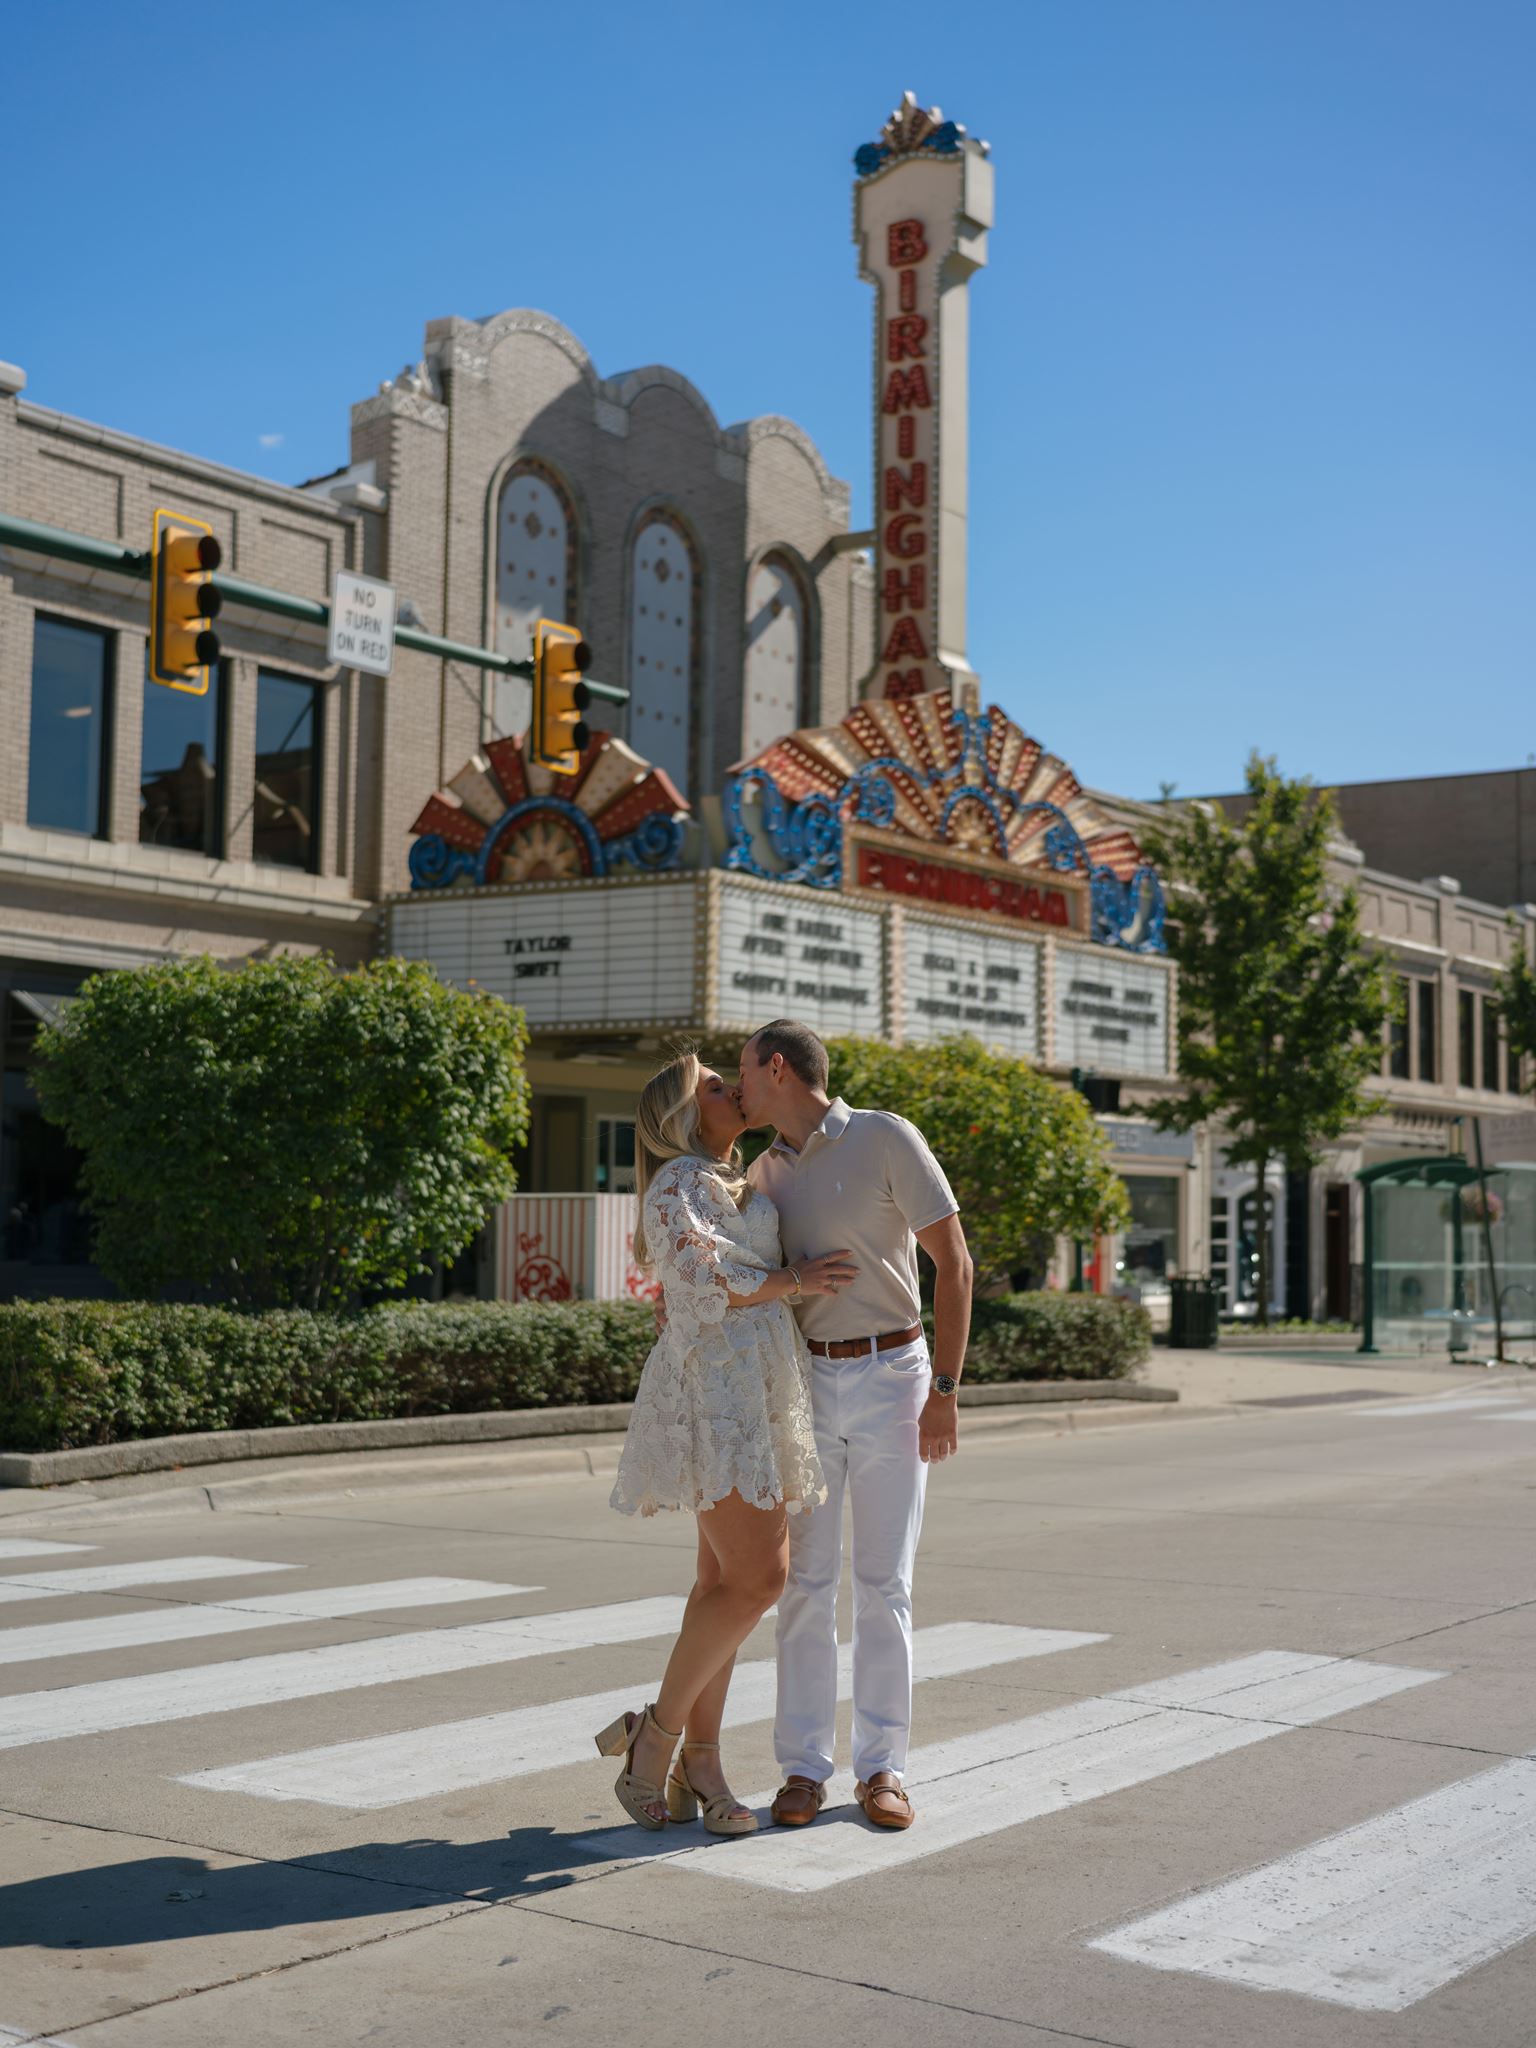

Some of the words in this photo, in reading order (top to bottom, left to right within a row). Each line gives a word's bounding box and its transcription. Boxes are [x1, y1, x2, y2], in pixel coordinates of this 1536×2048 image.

[882, 218, 931, 699] BIRMINGHAM
[354, 588, 376, 608] NO
[345, 609, 382, 634] TURN
[337, 632, 355, 651] ON
[361, 639, 388, 661] RED
[504, 935, 573, 955] TAYLOR
